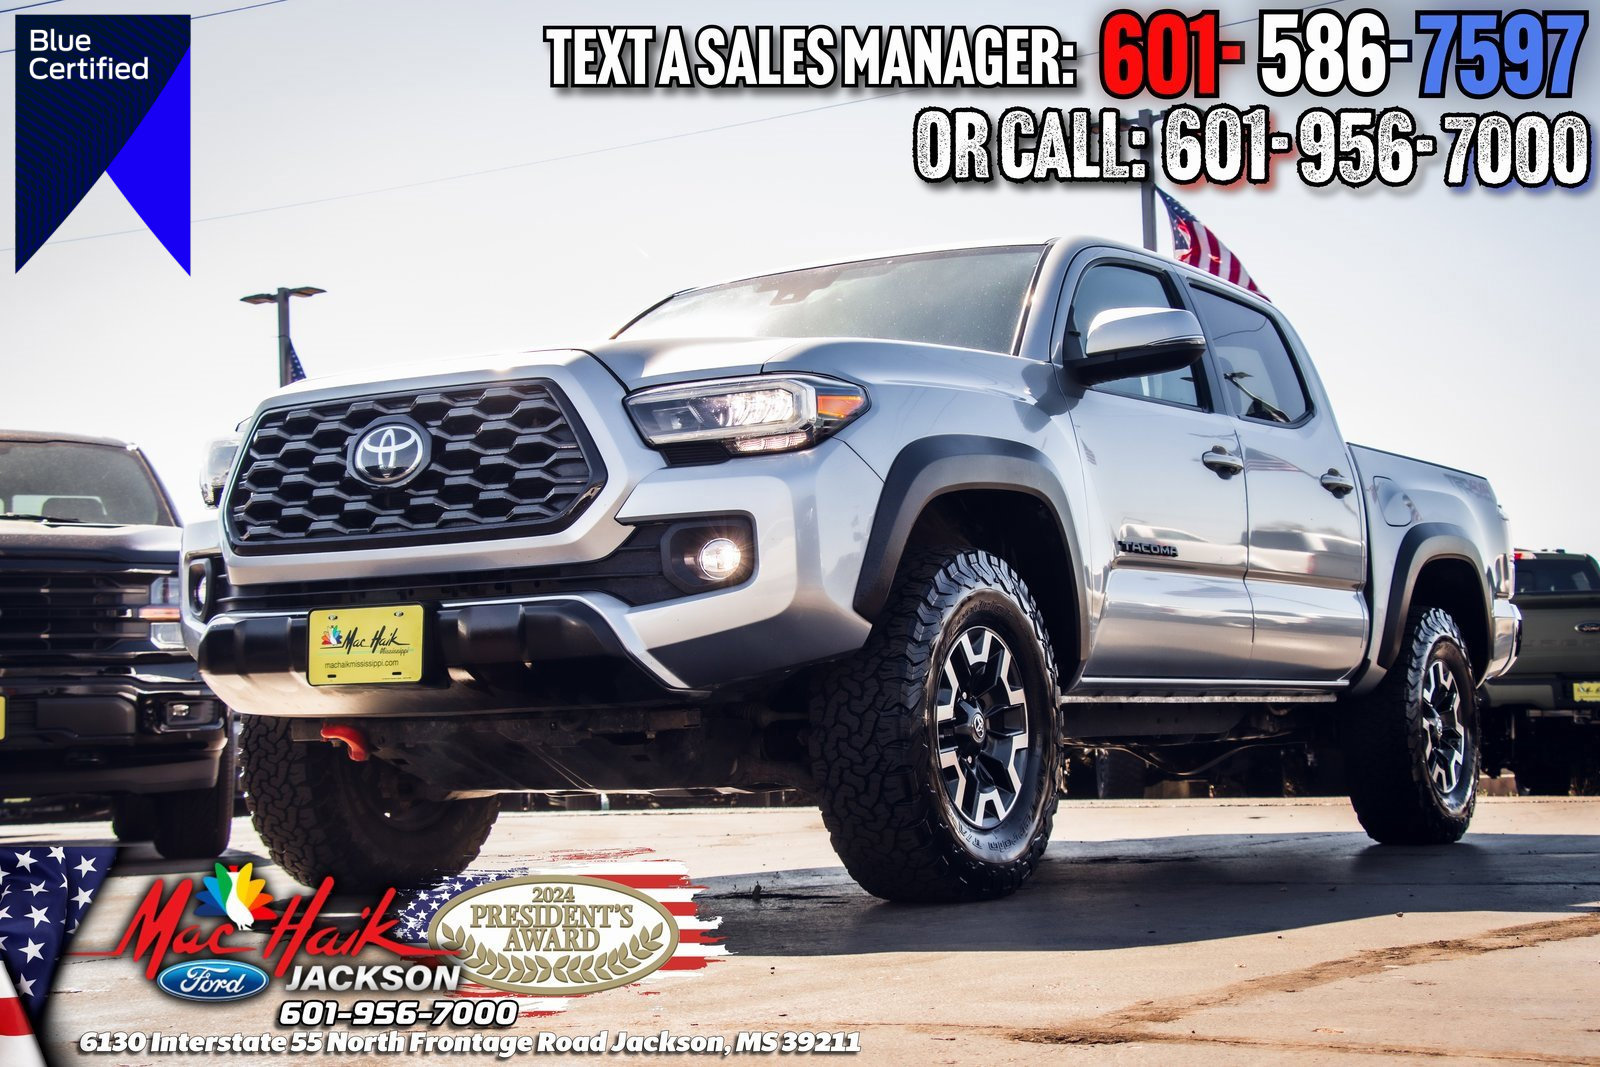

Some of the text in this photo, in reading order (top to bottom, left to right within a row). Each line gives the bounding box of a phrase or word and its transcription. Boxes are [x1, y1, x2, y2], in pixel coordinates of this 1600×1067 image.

[1123, 541, 1179, 557] TACOMA
[334, 624, 406, 655] Mac Haik
[324, 658, 399, 670] machaikmississippi.com
